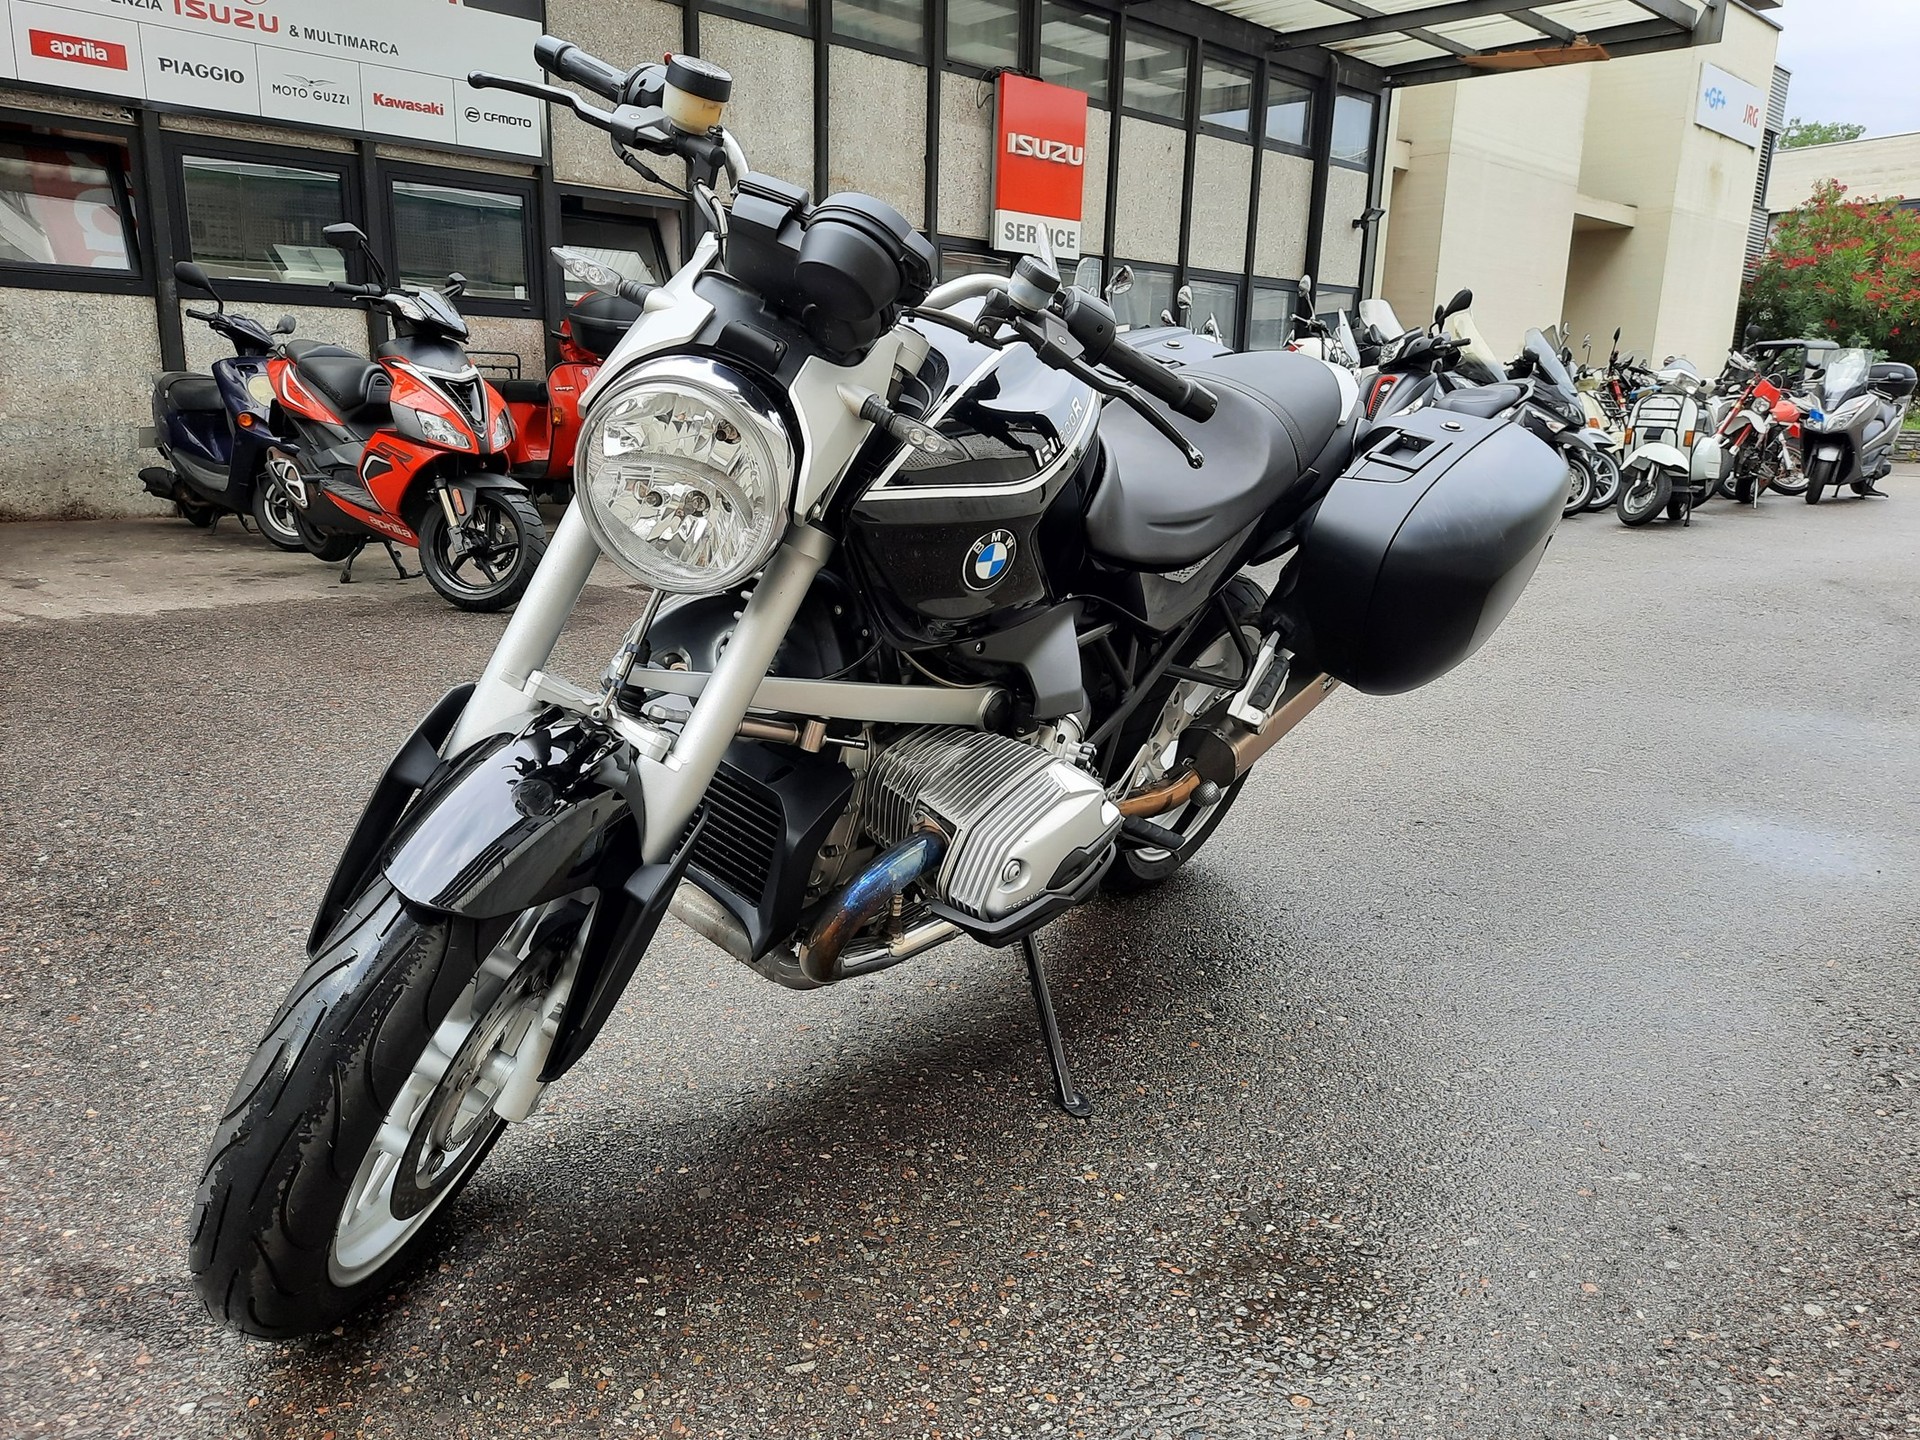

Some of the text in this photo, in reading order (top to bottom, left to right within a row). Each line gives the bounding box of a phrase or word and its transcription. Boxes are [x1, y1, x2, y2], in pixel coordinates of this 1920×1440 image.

[173, 0, 279, 33] ISUZU
[289, 24, 300, 38] &
[303, 27, 400, 56] MULTIMARCA
[50, 39, 109, 62] aprilia
[157, 57, 245, 84] PIAGGIO
[272, 83, 351, 105] MOTO GUZZI
[373, 92, 444, 116] Kawasaki
[484, 112, 532, 129] CFMOTO
[1007, 132, 1084, 166] ISUZU
[1004, 221, 1077, 249] SERICE
[368, 515, 413, 539] aprilia
[972, 531, 1015, 555] BMW
